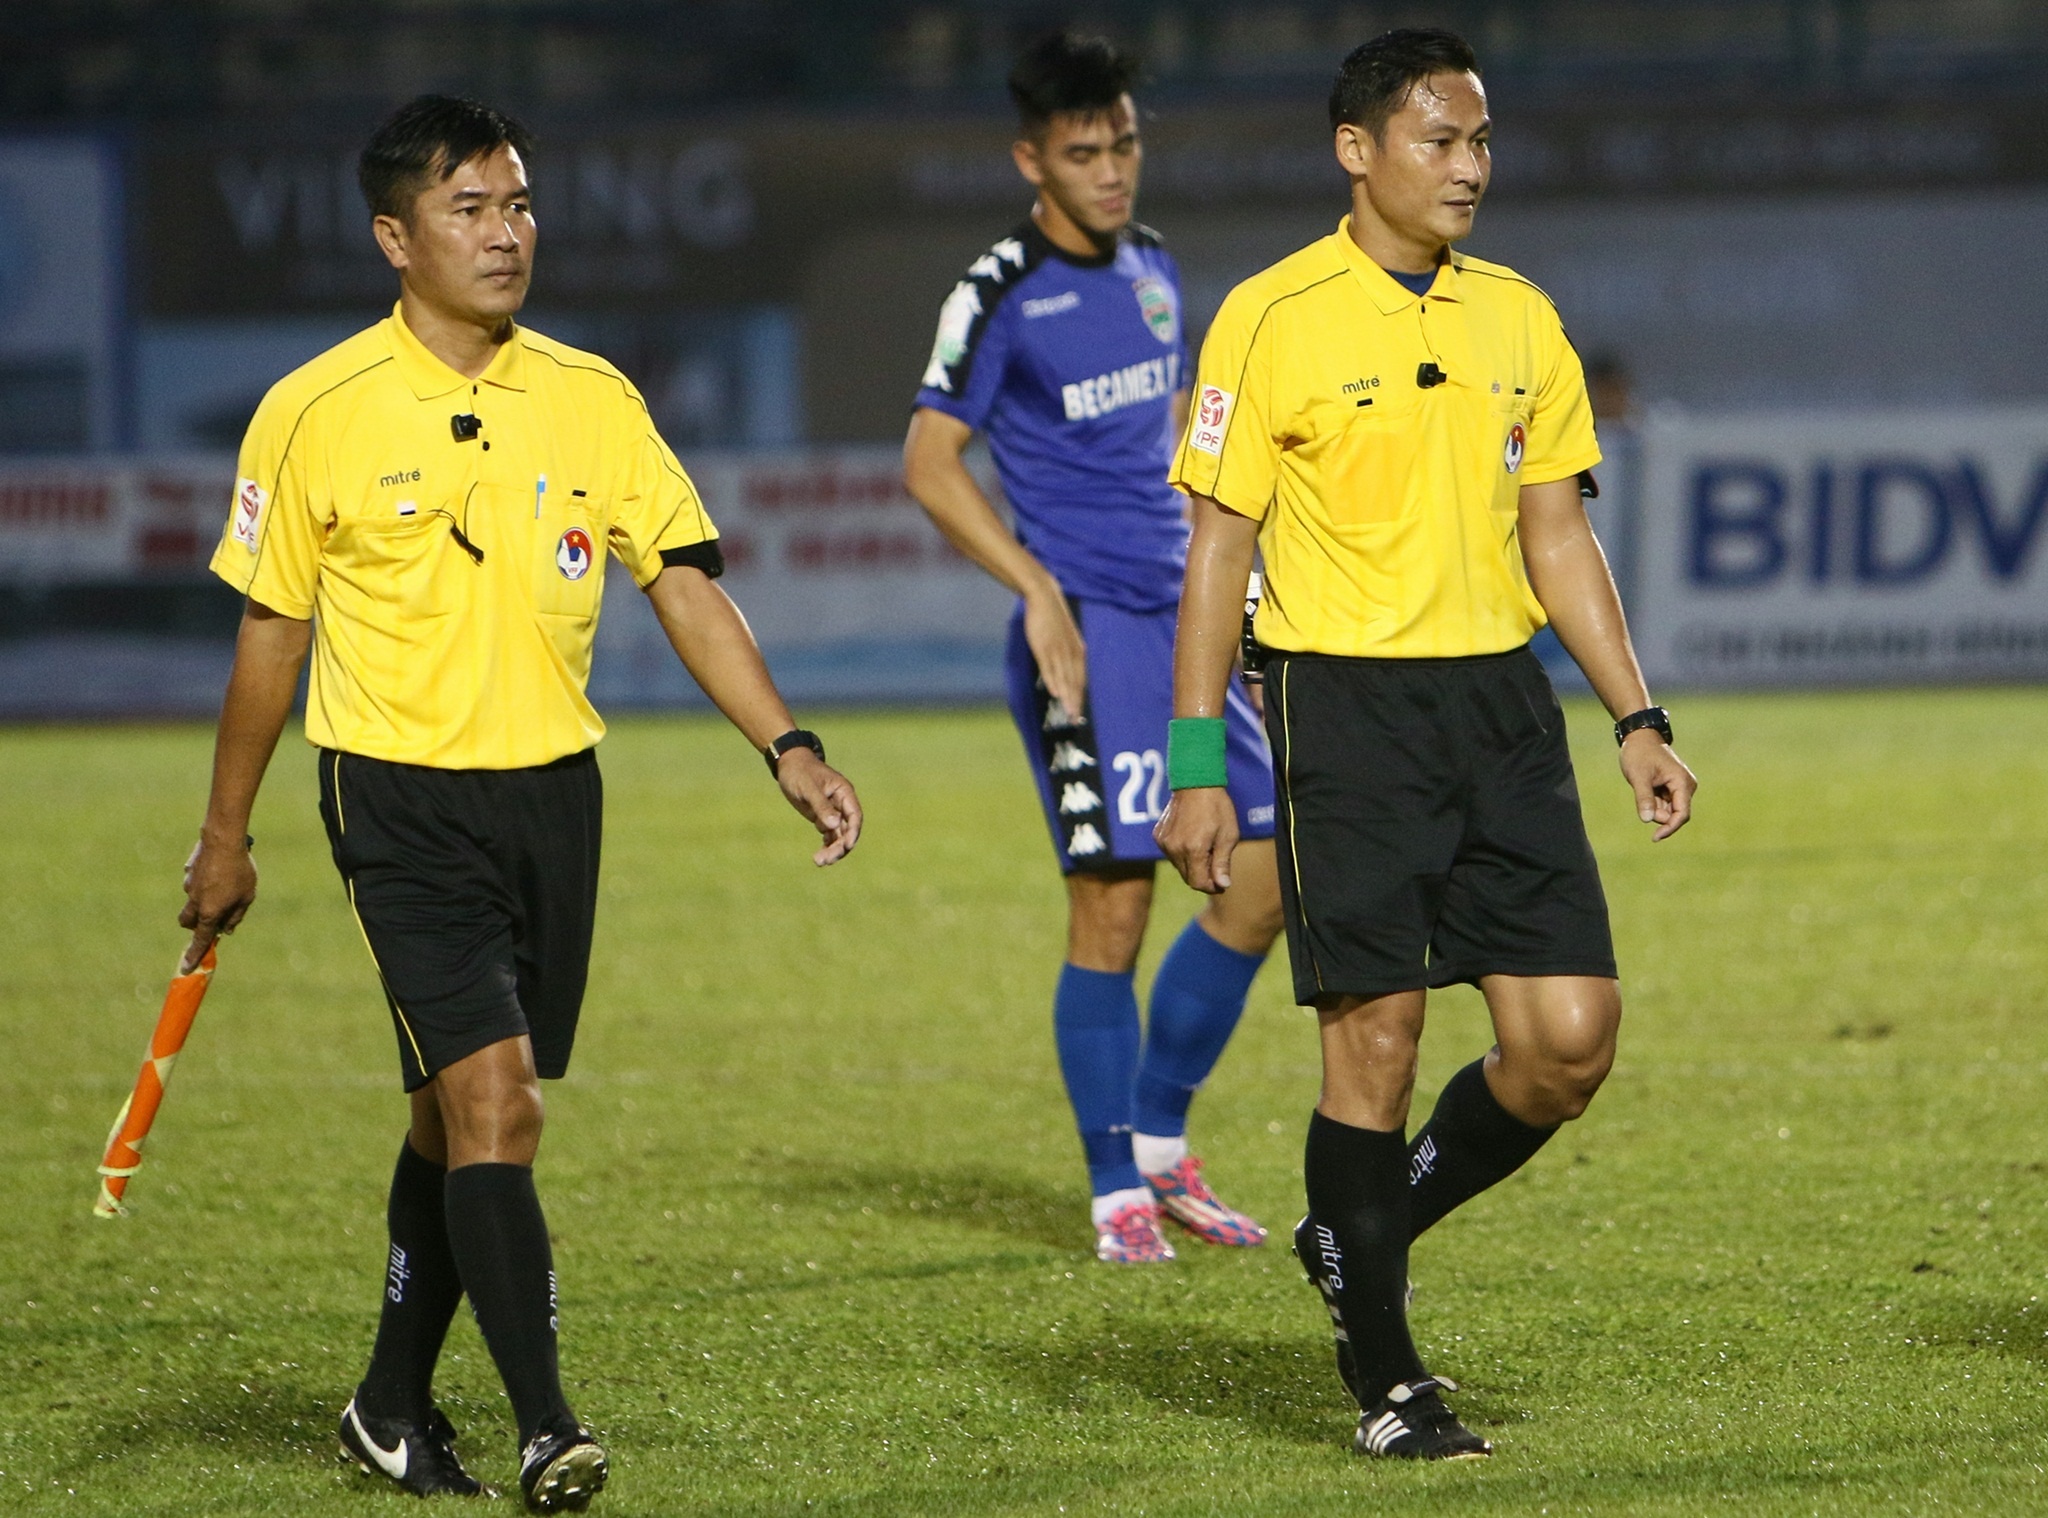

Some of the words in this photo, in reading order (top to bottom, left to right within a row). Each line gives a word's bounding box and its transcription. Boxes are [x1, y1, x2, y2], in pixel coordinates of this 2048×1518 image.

[1061, 357, 1166, 421] BECAMEX
[1342, 375, 1380, 395] mitre
[380, 468, 421, 488] mitre
[1684, 453, 2048, 590] BIDV
[1112, 748, 1166, 825] 22
[387, 1242, 411, 1303] mitre
[1315, 1224, 1343, 1290] mitre
